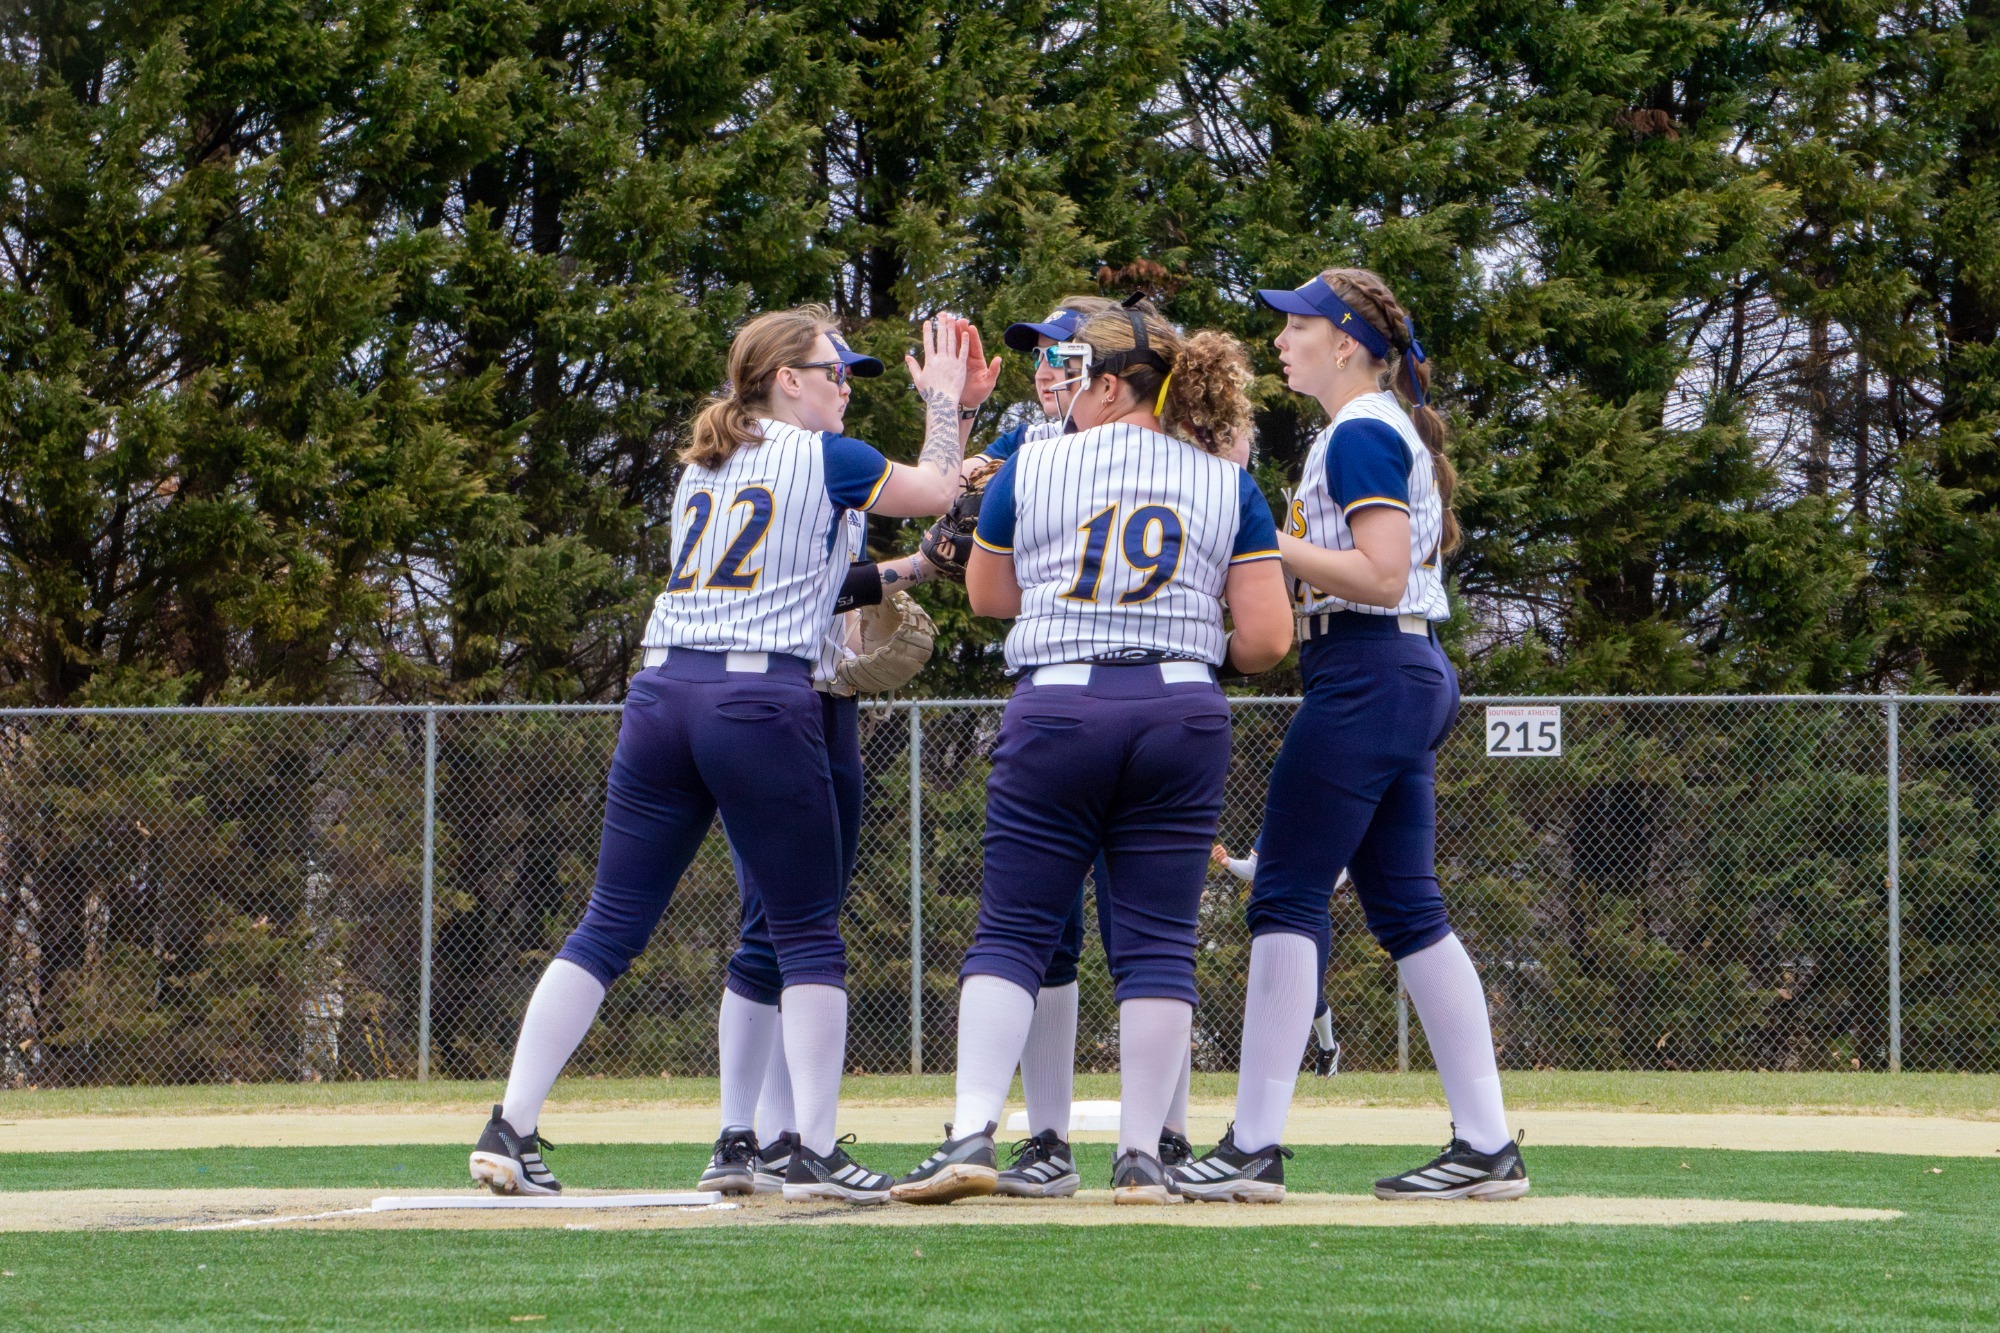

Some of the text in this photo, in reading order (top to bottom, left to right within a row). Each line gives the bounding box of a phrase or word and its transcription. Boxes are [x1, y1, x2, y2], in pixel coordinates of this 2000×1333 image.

[667, 486, 776, 594] 22
[1057, 500, 1185, 605] 19
[1490, 721, 1557, 752] 215
